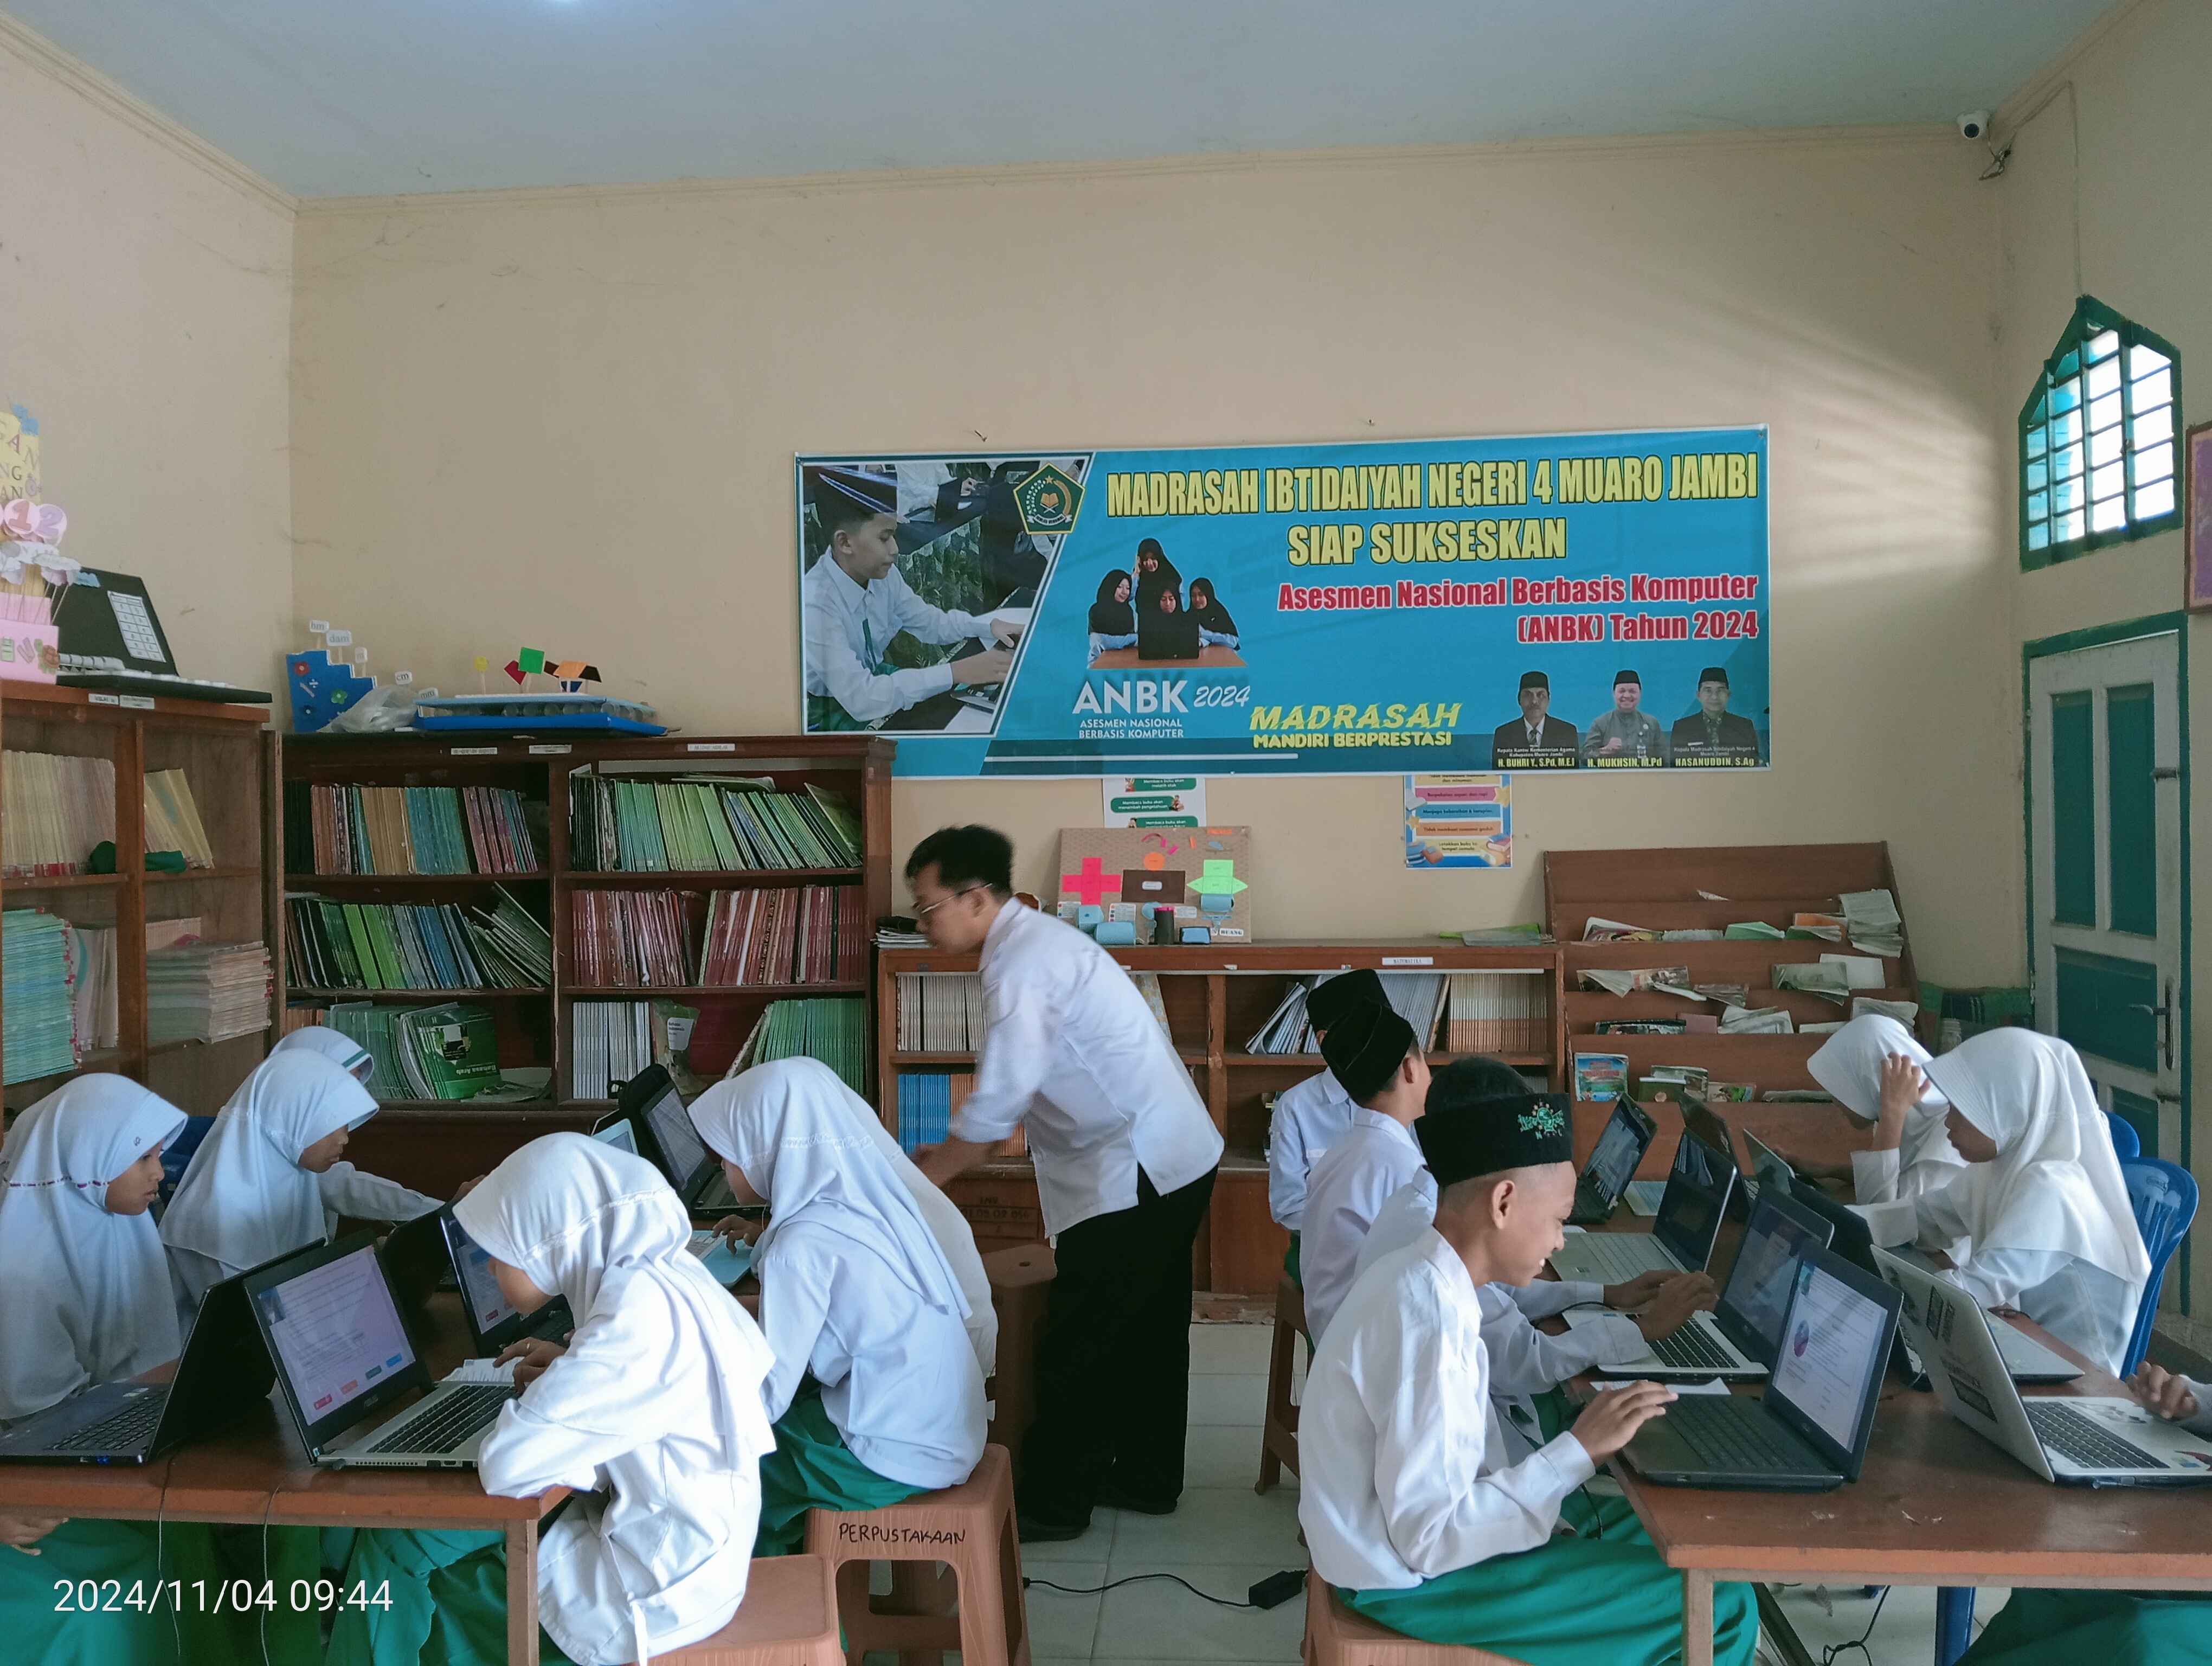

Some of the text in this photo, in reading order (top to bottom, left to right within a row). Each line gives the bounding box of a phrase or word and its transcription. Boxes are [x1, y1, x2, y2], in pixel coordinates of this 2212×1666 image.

[1107, 452, 1758, 517] MADRASAH IBTIDAIYAH NEGERI 4 MUARO JAMBI
[1288, 517, 1566, 566] SIAP SUKSESKAN
[1278, 574, 1758, 611] Asesmen Nasional Berbasis Komputer
[1517, 610, 1759, 643] (ANBK) Tahun 2024
[329, 634, 350, 643] dam
[396, 672, 408, 681] cm
[1072, 680, 1250, 714] ANBK 2024
[1080, 718, 1182, 728] ASESMEN NASIONAL
[1249, 702, 1462, 731] MADRASAH
[1079, 729, 1184, 739] BERBASIS KOMPUTER
[1253, 731, 1452, 748] MANDIRI BERPRESTASI
[1498, 758, 1505, 767] H.
[1506, 758, 1529, 767] BUHRI
[1587, 758, 1596, 767] H.
[1641, 757, 1662, 767] M.Pd
[1735, 757, 1754, 766] S.Ag
[839, 1522, 966, 1545] PERPUSTAKAAN
